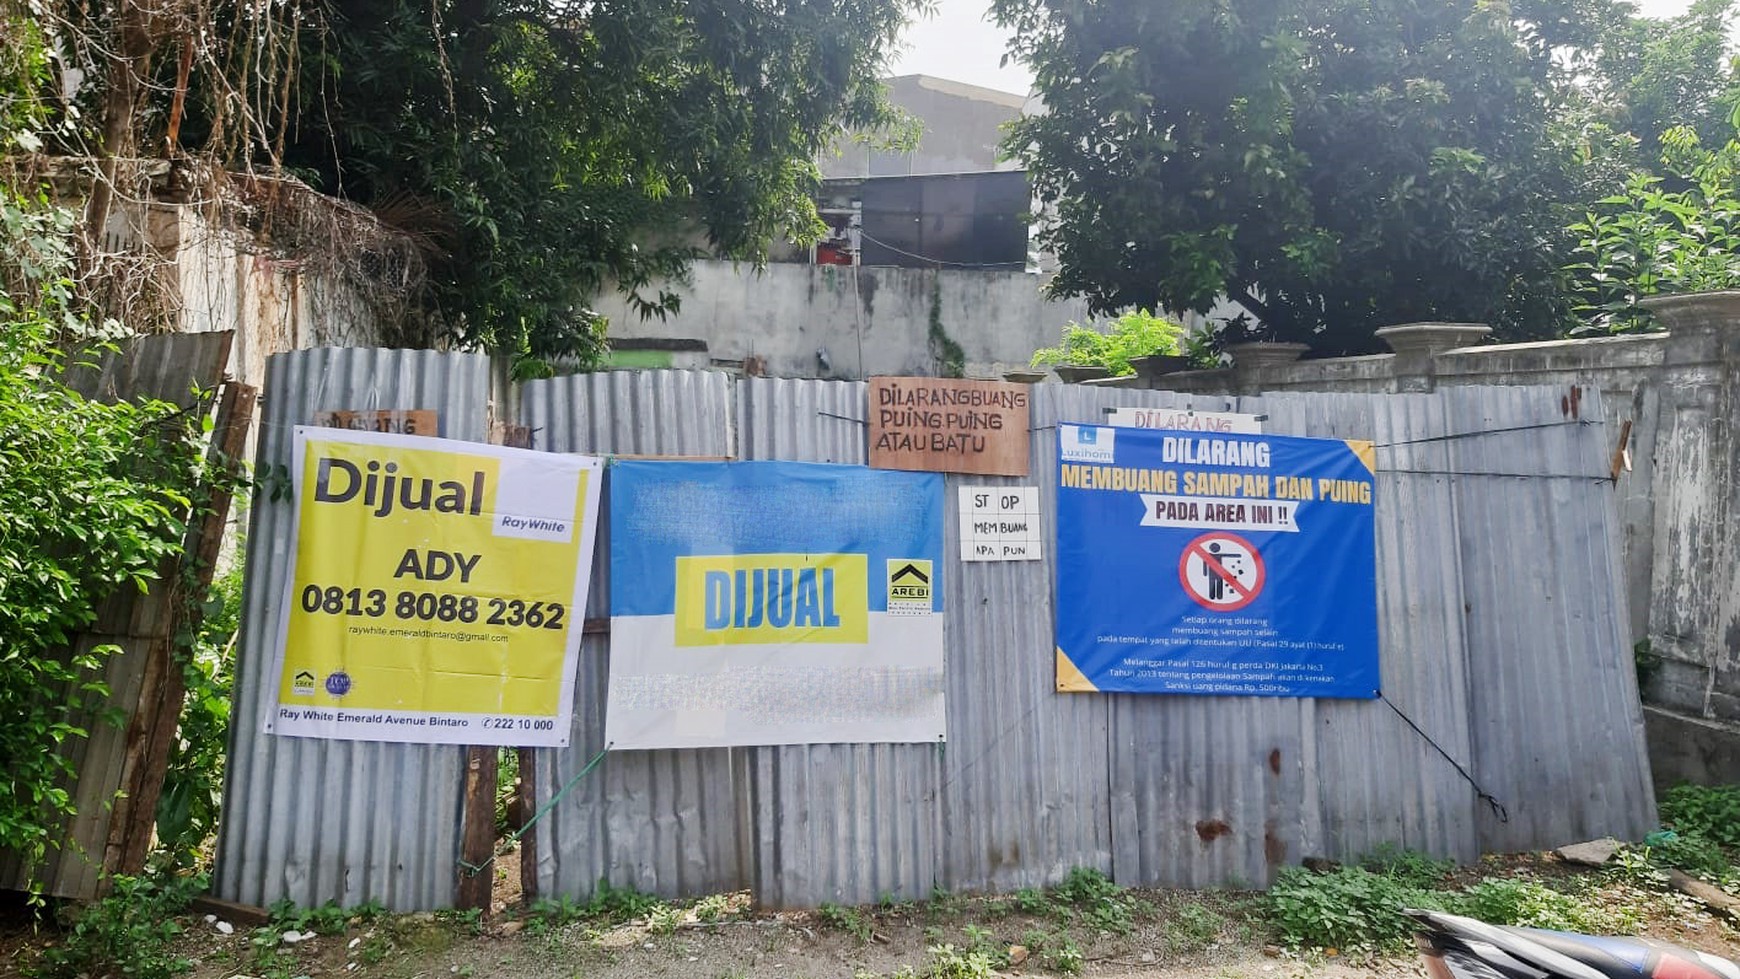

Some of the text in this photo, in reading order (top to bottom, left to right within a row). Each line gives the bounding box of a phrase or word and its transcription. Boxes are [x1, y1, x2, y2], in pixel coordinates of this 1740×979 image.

[875, 432, 985, 454] ATAU BATU
[1162, 436, 1270, 468] DILARANG
[314, 457, 486, 518] Dijual
[1061, 464, 1371, 504] MEMBUANG SAMPAH DAN PUING
[1155, 501, 1199, 521] PADA
[1204, 503, 1246, 523] AREA
[1251, 505, 1273, 524] INI
[501, 515, 565, 534] RayWhite
[976, 545, 1025, 556] APA PUN
[393, 549, 482, 583] ADY
[704, 567, 840, 630] DIJUAL
[892, 587, 928, 597] AREBI
[302, 584, 565, 630] 0813 8088 2362
[1097, 635, 1118, 643] pada
[1172, 626, 1219, 636] membuang
[280, 708, 553, 730] Ray White Emerald Avenue Bintaro 222 10 000
